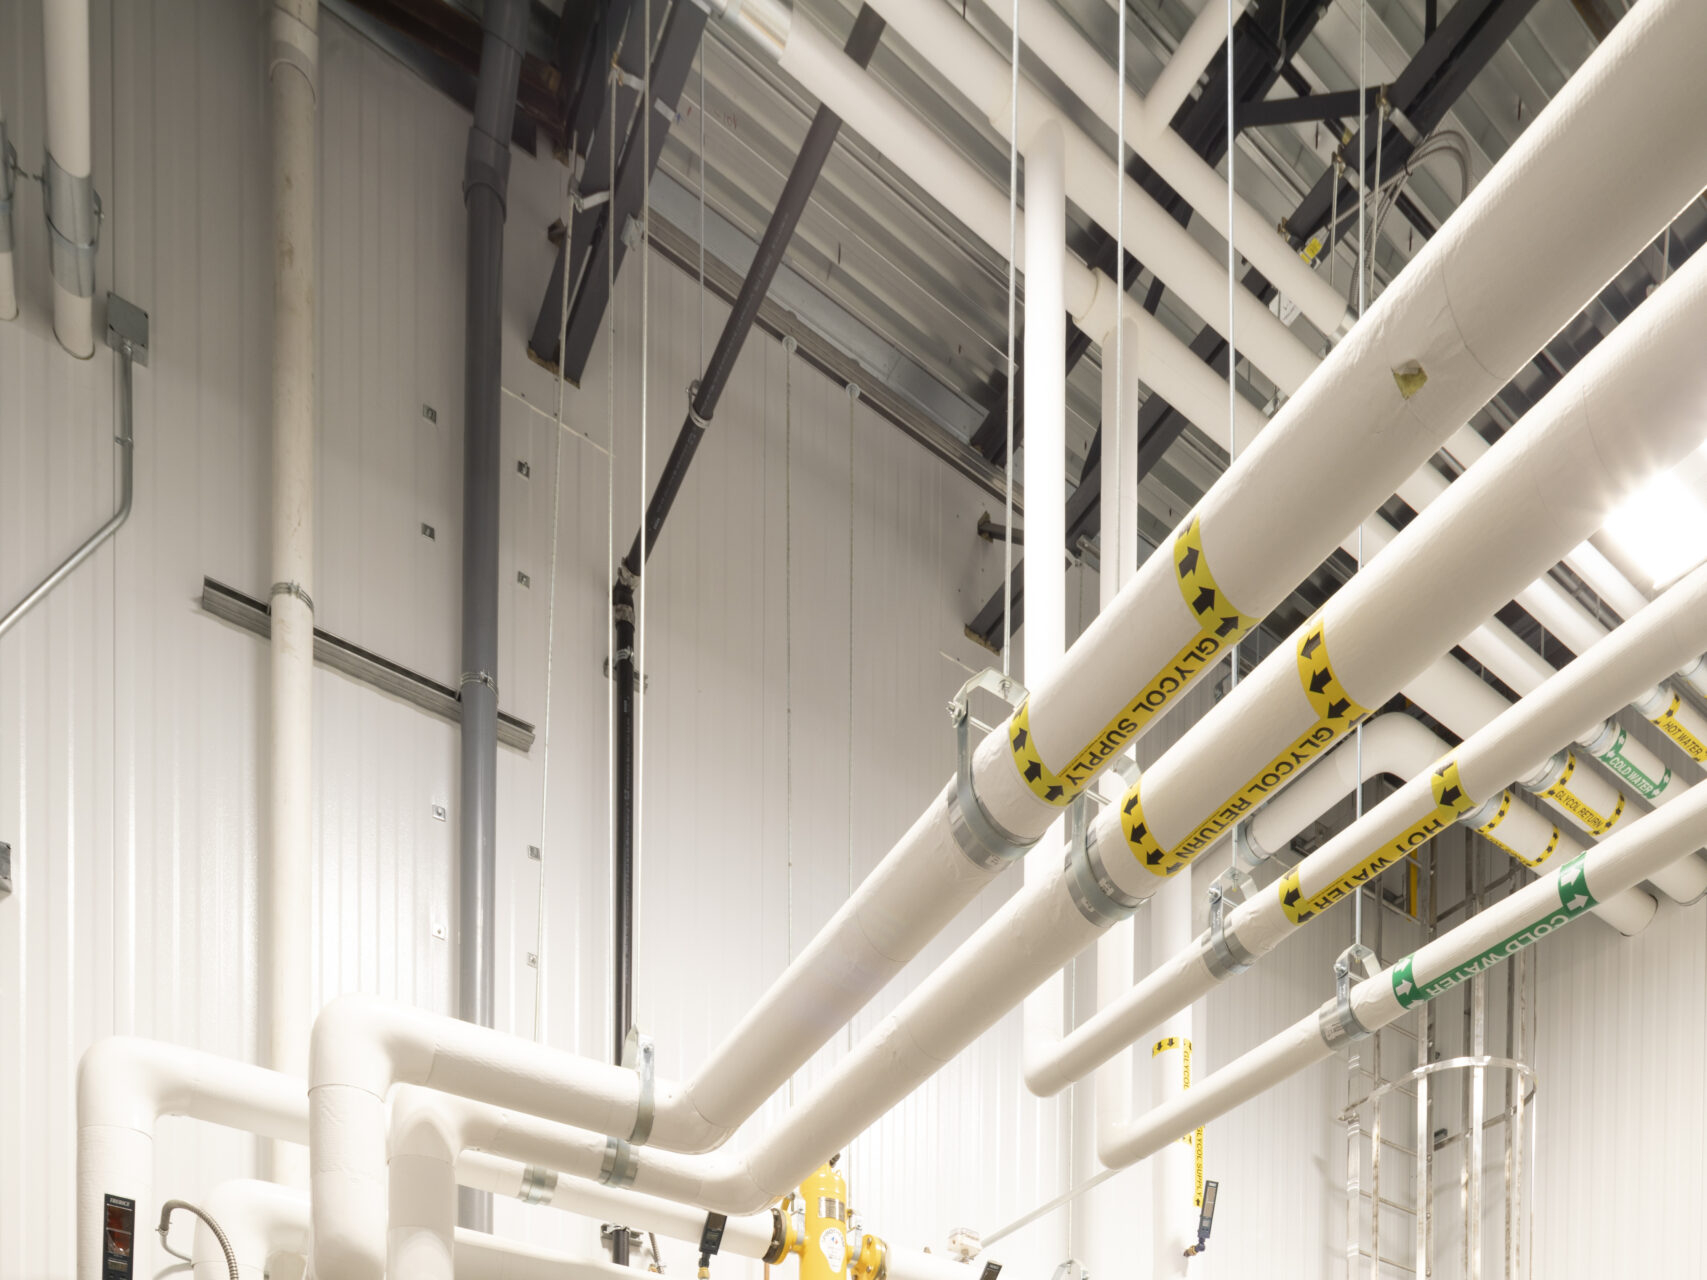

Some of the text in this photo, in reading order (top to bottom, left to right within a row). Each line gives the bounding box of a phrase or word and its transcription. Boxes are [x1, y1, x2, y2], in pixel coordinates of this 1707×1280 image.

[1065, 637, 1220, 787] GLYCOL SUPPLY
[1663, 720, 1703, 756] HOT WATER
[1175, 726, 1335, 860] GLYCOL RETURN
[1609, 756, 1654, 794] COLD WATER
[1555, 790, 1604, 828] GLYCOL RETURN
[1426, 914, 1569, 996] COLD WATER
